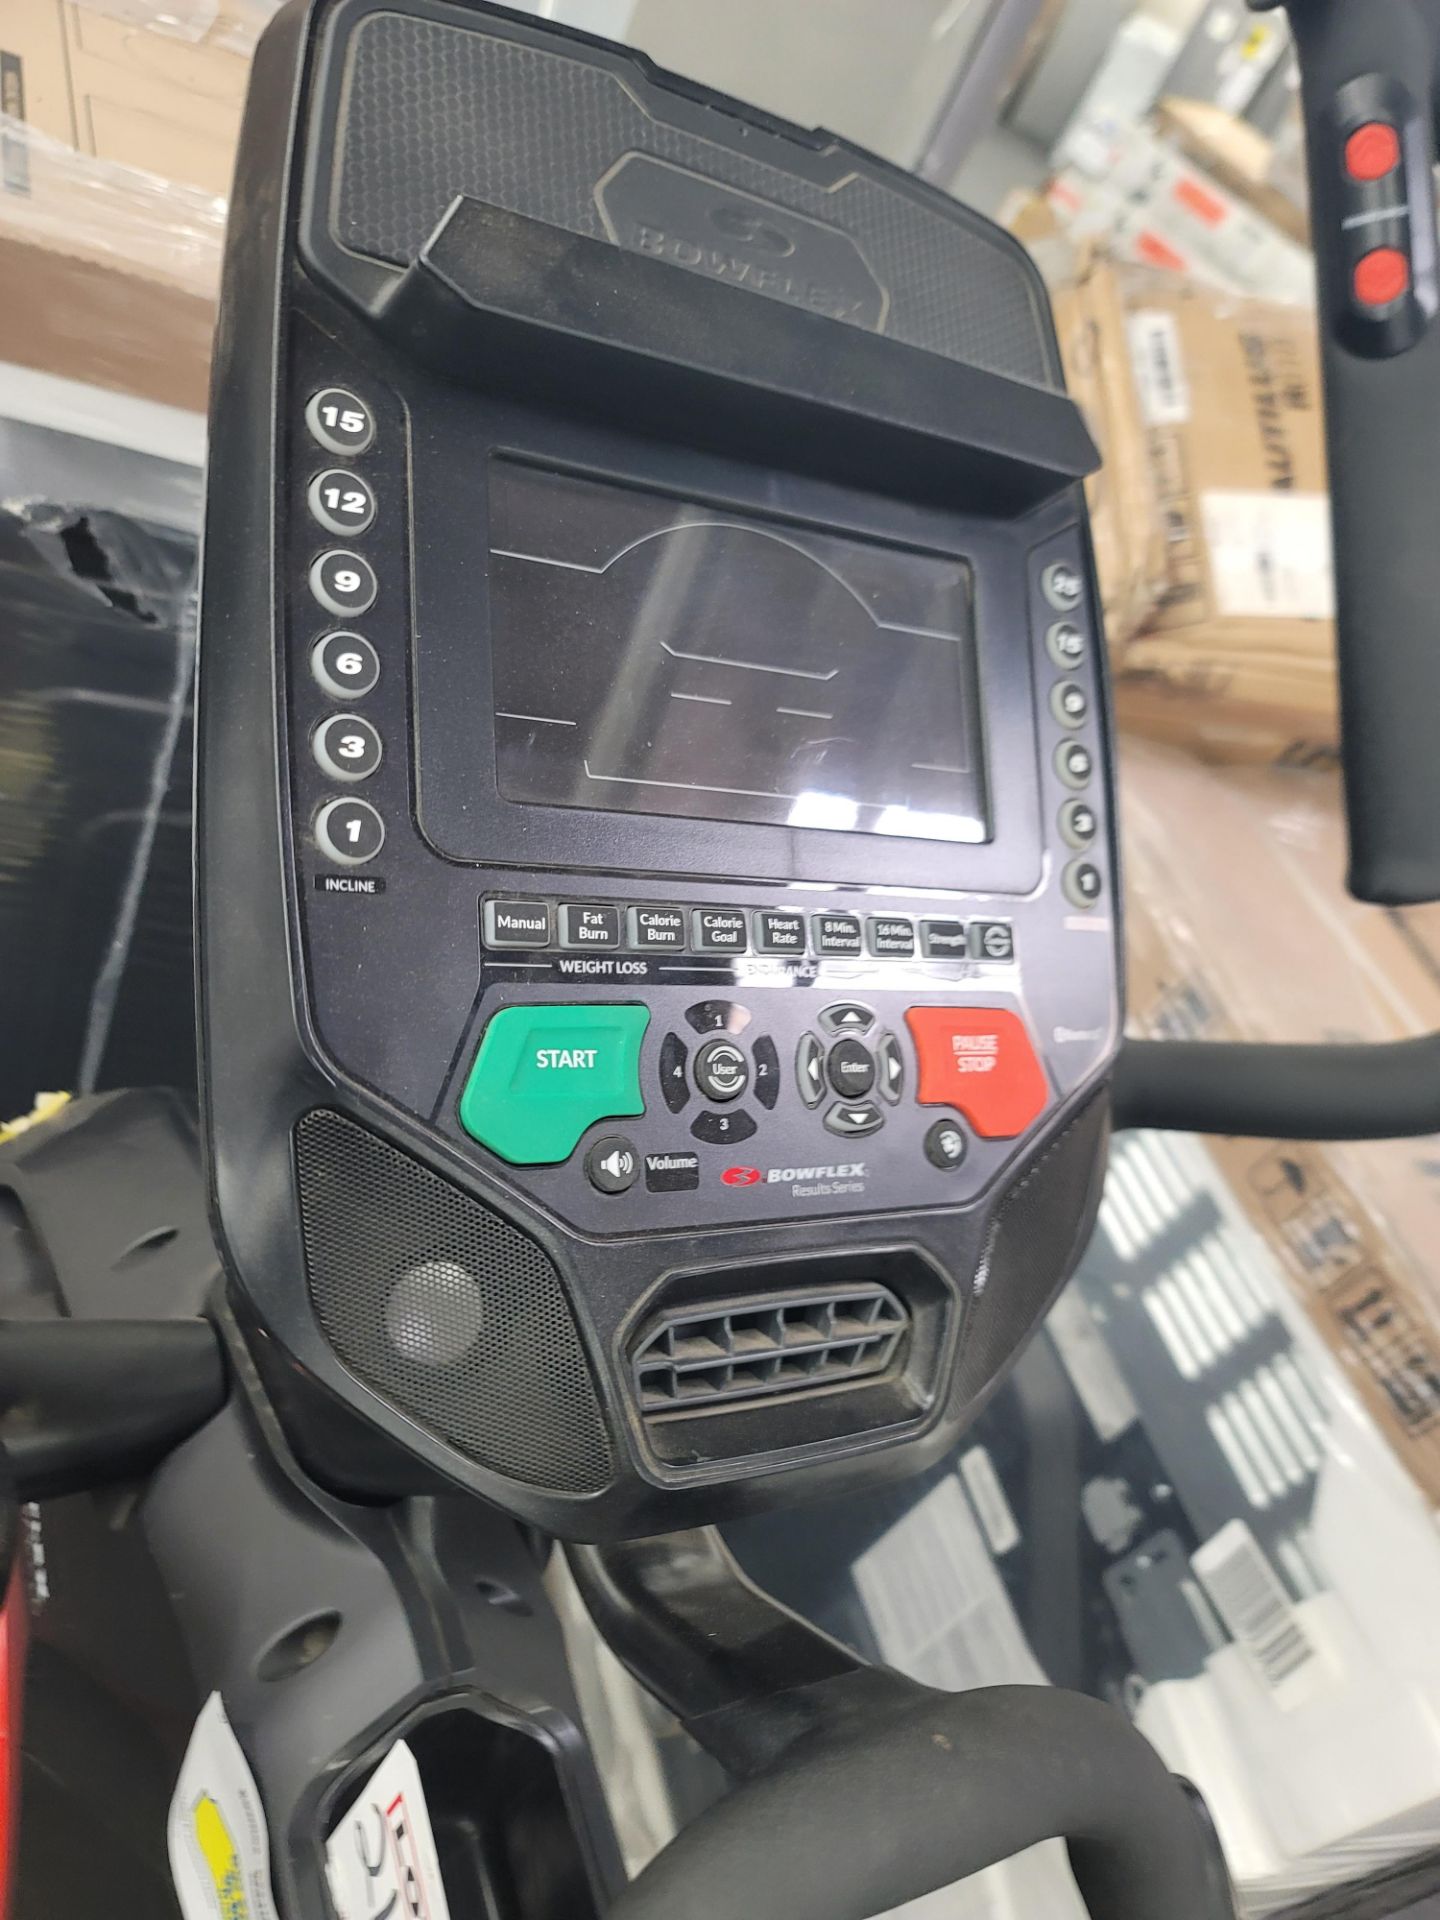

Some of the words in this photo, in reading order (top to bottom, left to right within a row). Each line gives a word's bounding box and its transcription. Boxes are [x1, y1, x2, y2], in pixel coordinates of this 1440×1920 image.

[637, 224, 866, 322] BOWFLEX
[322, 406, 365, 433] 15
[324, 487, 367, 514] 12
[334, 570, 361, 593] 9
[336, 652, 363, 675] 6
[338, 735, 366, 758] 3
[1074, 812, 1093, 832] 3
[346, 819, 362, 843] 1
[325, 877, 376, 893] INCLINE
[1080, 872, 1097, 892] 1
[497, 914, 546, 930] Manual
[582, 911, 604, 925] Fat
[639, 912, 682, 927] Calorie
[703, 915, 744, 929] Calorie
[767, 917, 800, 930] Heart
[578, 926, 609, 940] Burn
[646, 928, 676, 941] Burn
[824, 921, 833, 933] 8
[877, 923, 890, 936] 16
[711, 930, 738, 943] Goal
[771, 931, 799, 945] Rate
[821, 934, 860, 948] Interval
[876, 937, 914, 950] Interval
[559, 959, 616, 975] WEIGHT
[616, 961, 648, 975] LOSS
[714, 1014, 724, 1027] 1
[535, 1049, 598, 1068] START
[956, 1056, 997, 1073] STOP
[672, 1065, 684, 1078] 4
[712, 1063, 739, 1075] User
[758, 1063, 769, 1076] 2
[840, 1061, 870, 1073] Enter
[719, 1118, 730, 1131] 3
[646, 1156, 699, 1171] Volume
[767, 1162, 867, 1184] BOWFLEX
[792, 1182, 833, 1197] Results
[832, 1180, 865, 1195] Series
